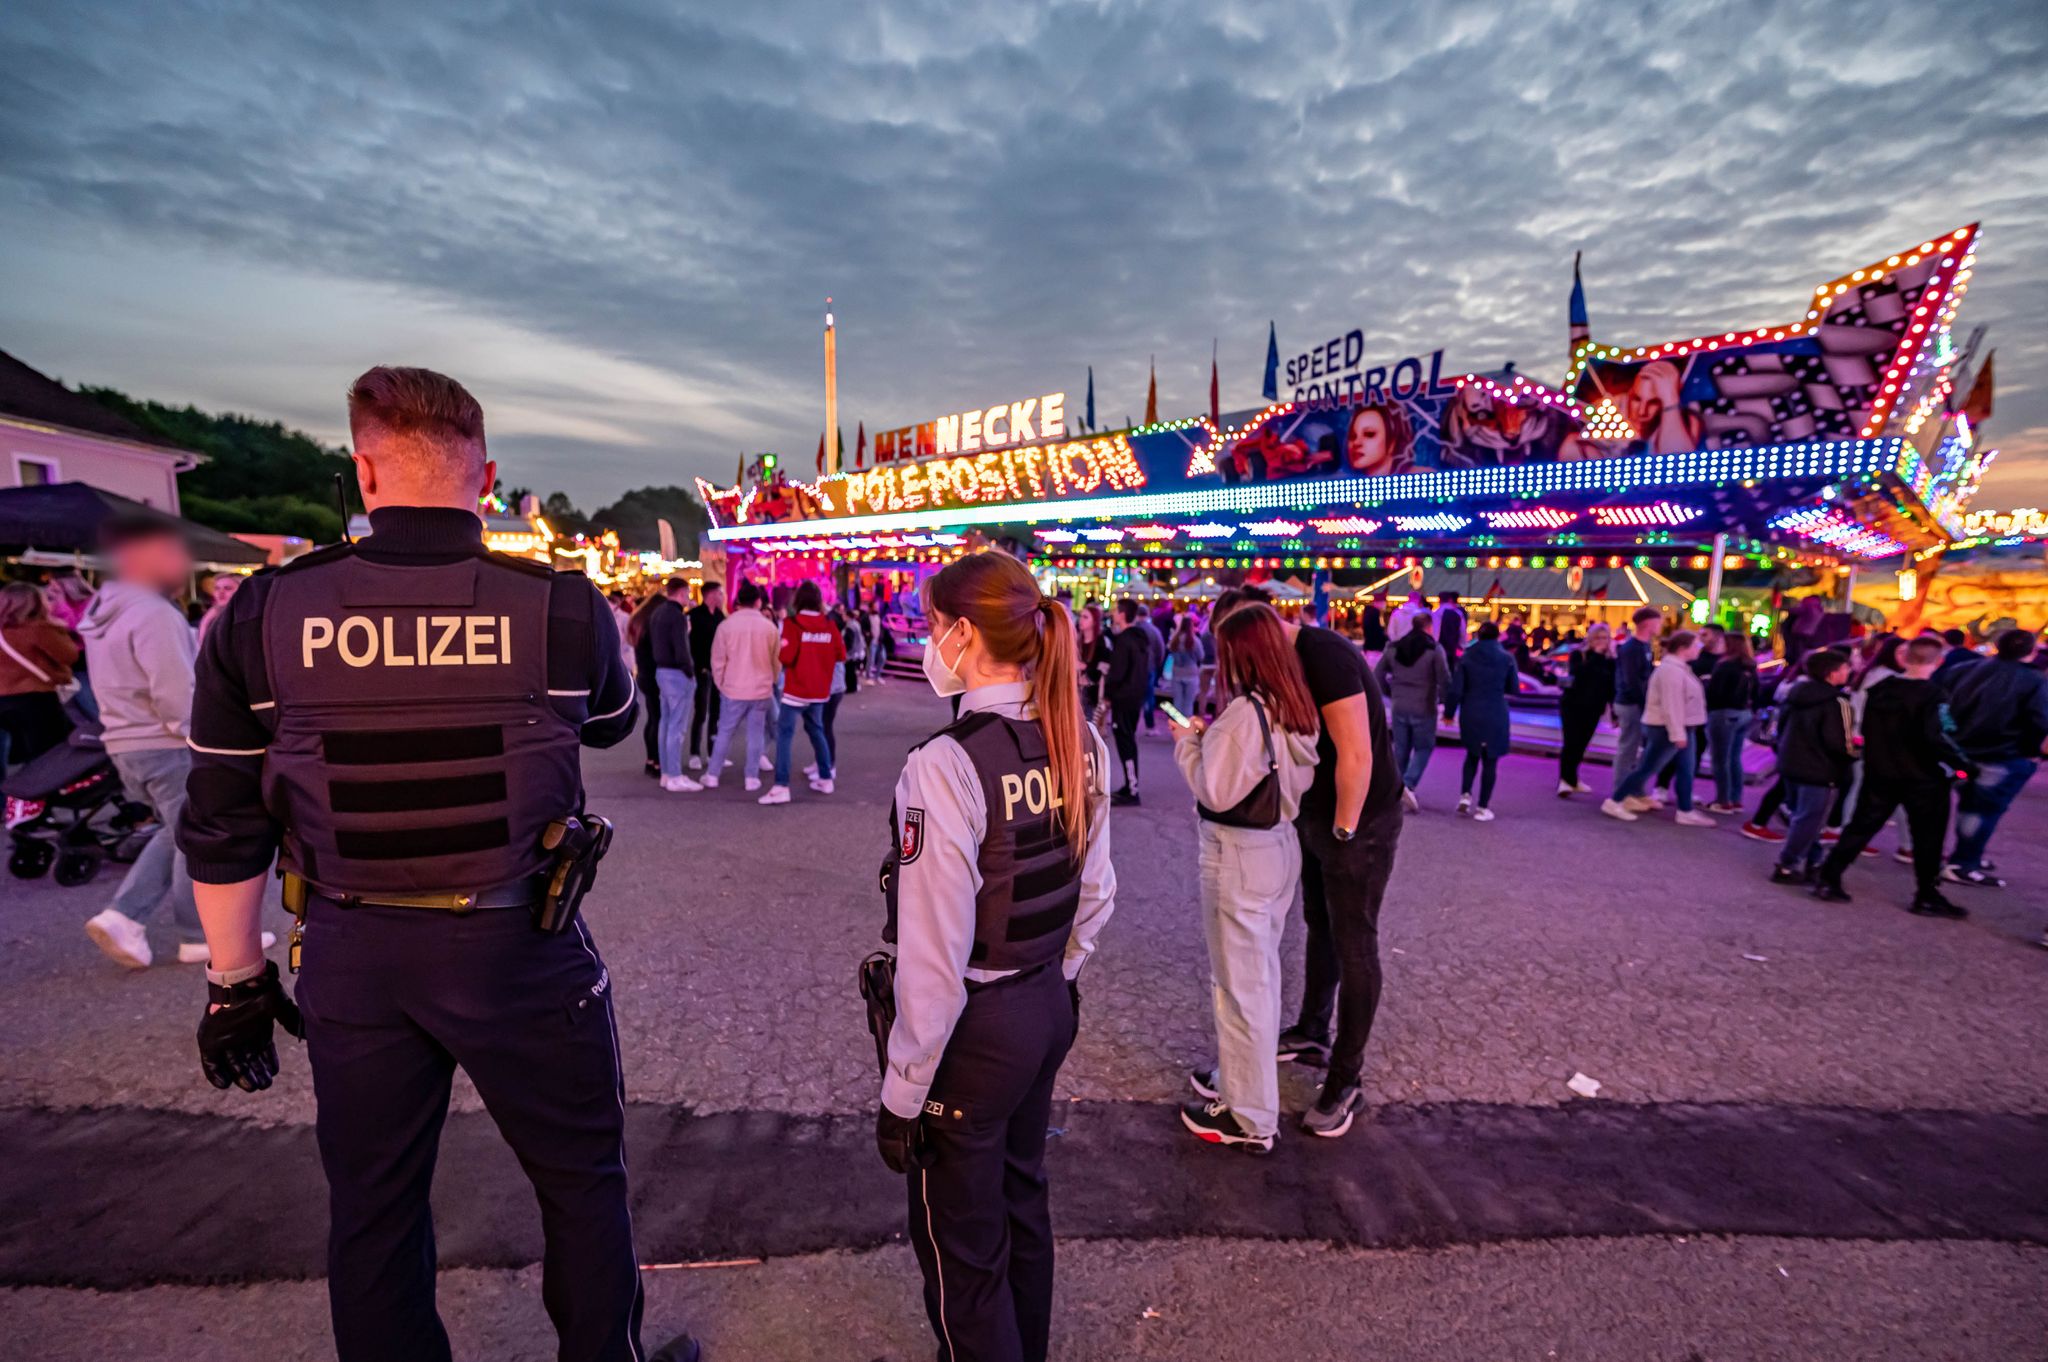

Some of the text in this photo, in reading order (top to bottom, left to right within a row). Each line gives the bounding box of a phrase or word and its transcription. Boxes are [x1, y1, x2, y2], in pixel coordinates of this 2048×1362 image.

[1286, 328, 1364, 386] SPEED
[1294, 349, 1459, 413] CONTROL
[874, 392, 1064, 465] MENNECKE
[302, 615, 512, 668] POLIZEI
